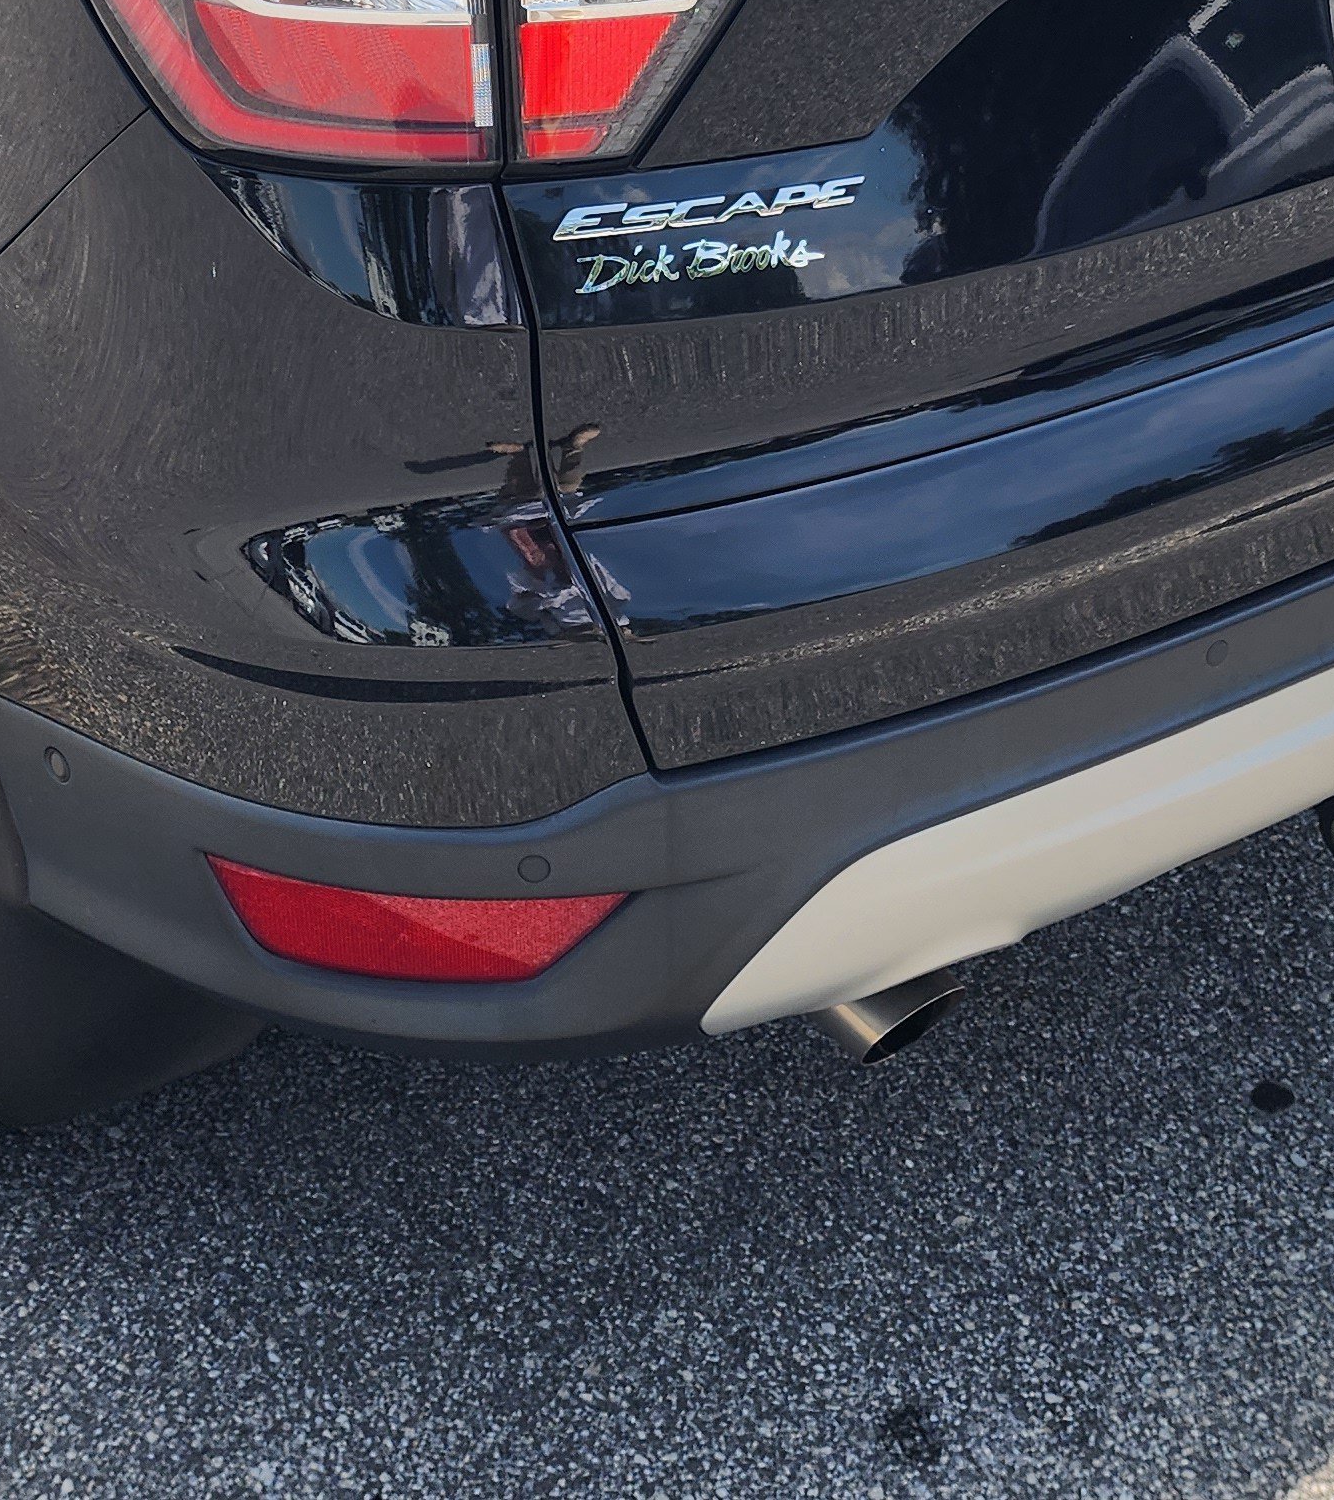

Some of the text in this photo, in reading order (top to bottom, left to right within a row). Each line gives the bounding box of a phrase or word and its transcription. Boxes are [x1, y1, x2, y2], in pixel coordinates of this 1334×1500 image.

[553, 175, 865, 241] ESCAPE
[575, 230, 826, 294] Dick Brooks
